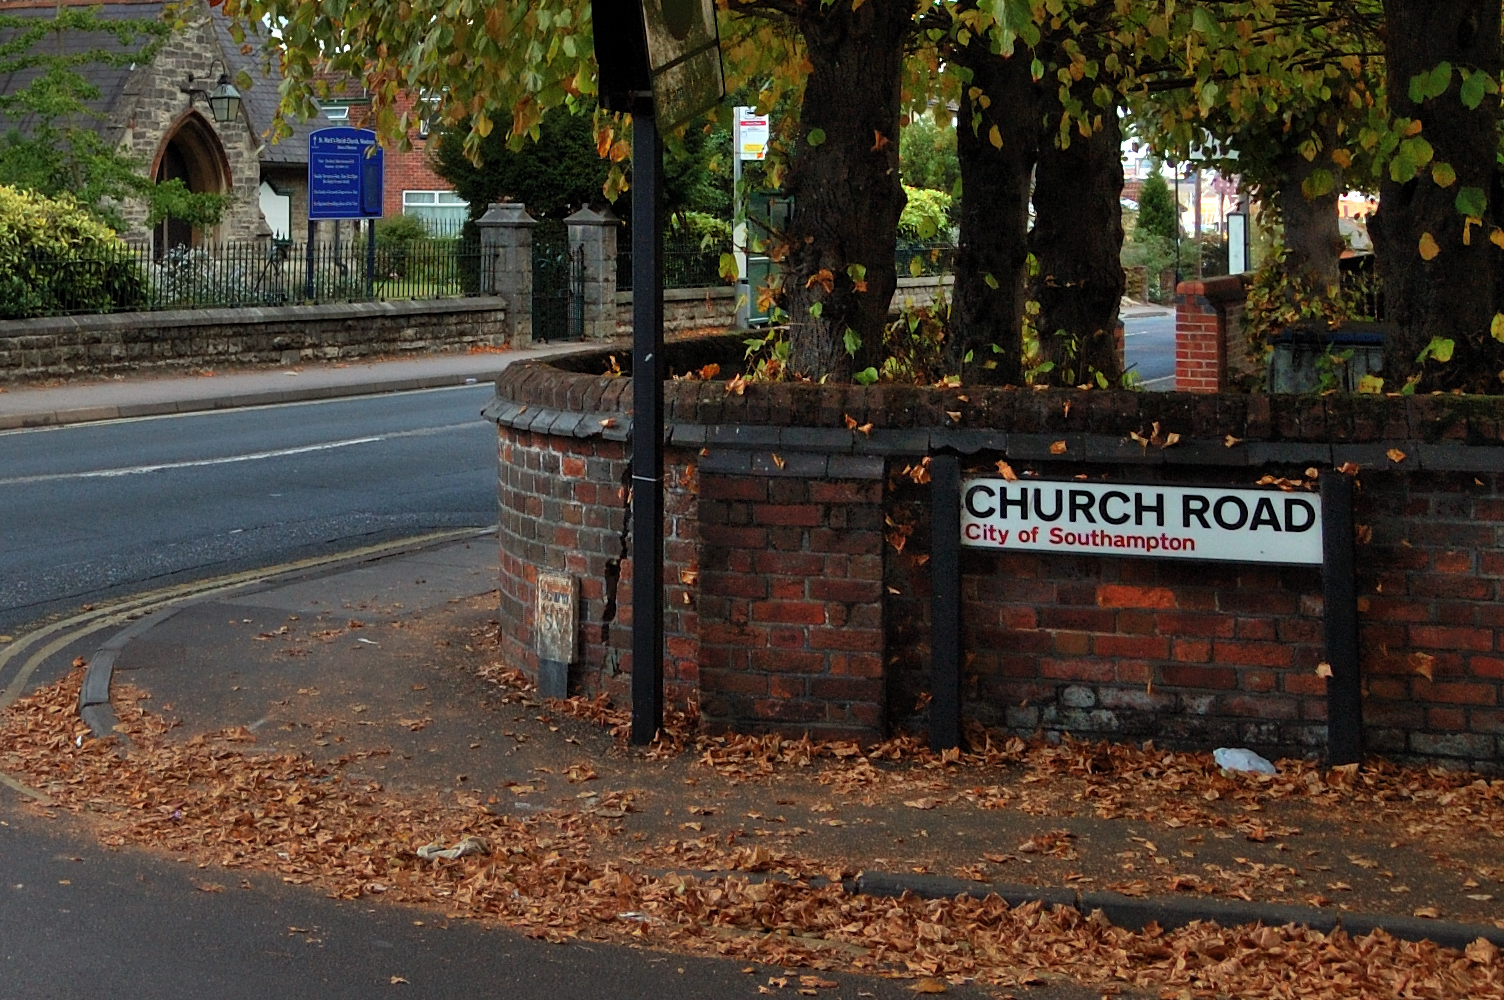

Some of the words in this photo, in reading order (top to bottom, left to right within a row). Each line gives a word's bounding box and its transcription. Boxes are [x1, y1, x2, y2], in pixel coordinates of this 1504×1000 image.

[964, 484, 1165, 527] CHURCH
[1181, 494, 1317, 533] ROAD
[964, 522, 1010, 545] City
[1018, 526, 1040, 544] of
[1048, 527, 1196, 552] Southampton
